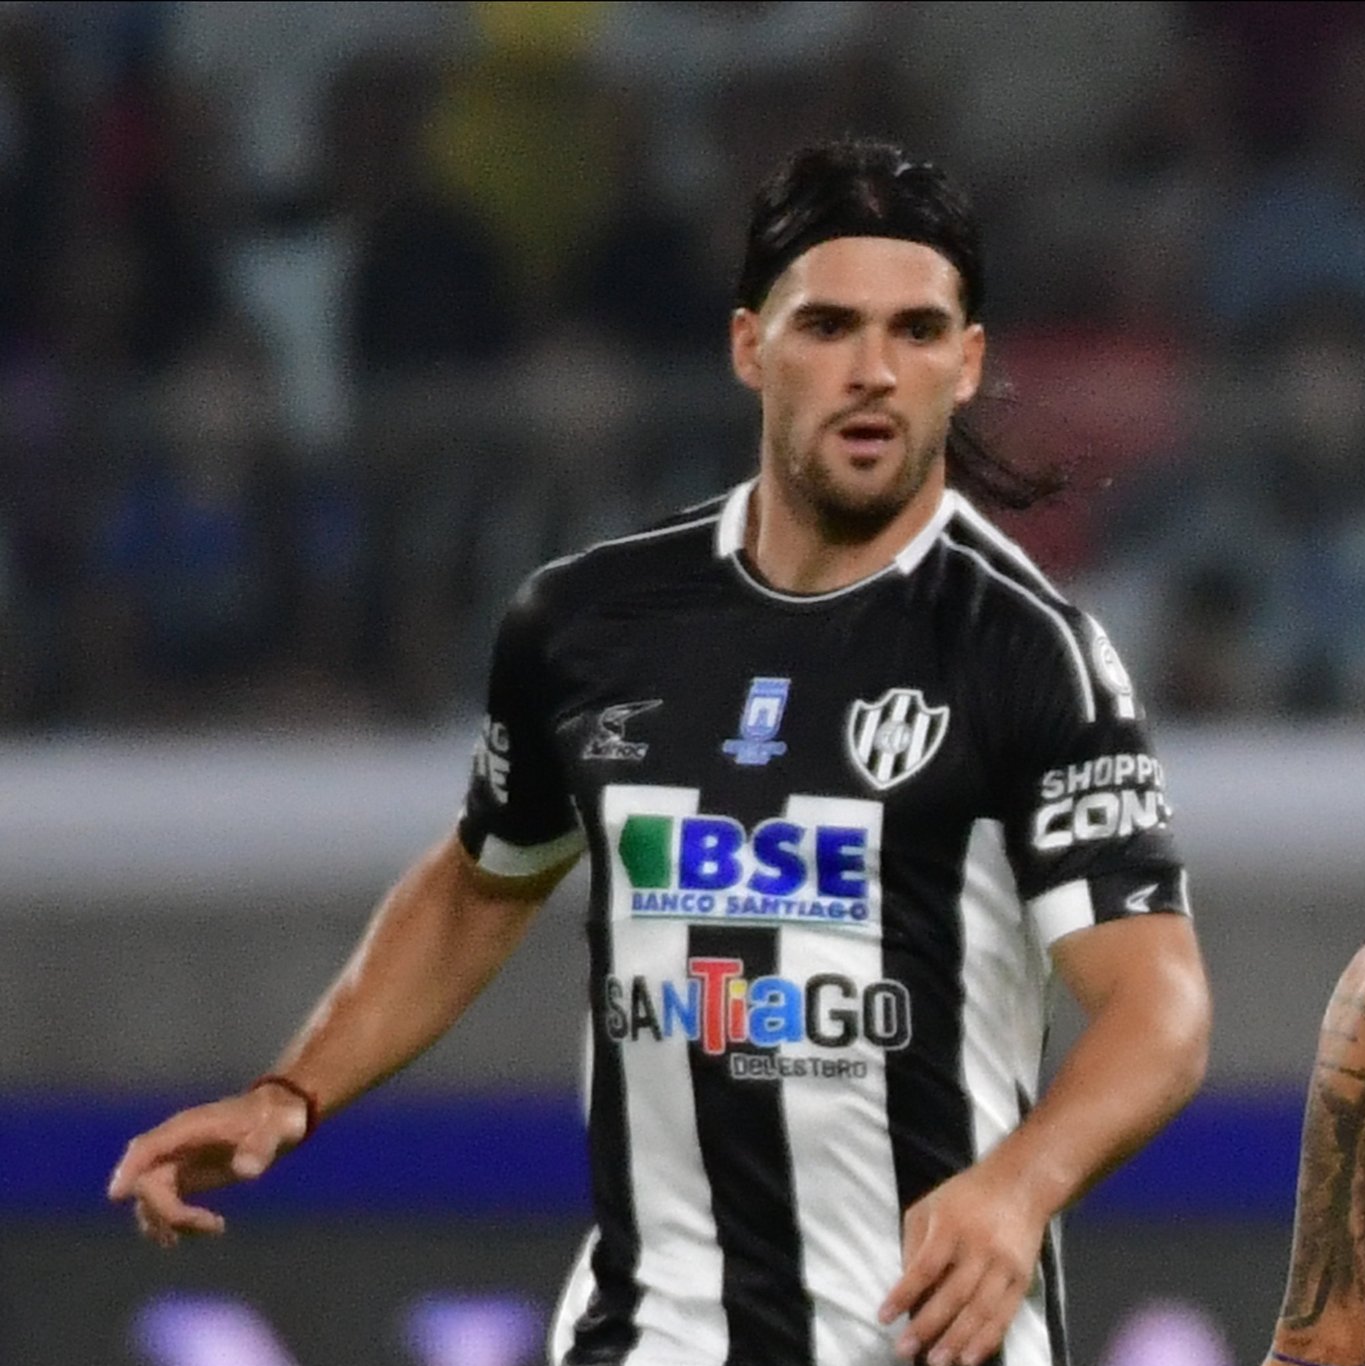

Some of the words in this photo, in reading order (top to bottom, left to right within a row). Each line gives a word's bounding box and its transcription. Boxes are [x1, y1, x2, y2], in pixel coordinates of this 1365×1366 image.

[677, 816, 868, 899] BSE
[632, 892, 716, 914] BANCO
[725, 894, 869, 922] SANTIAGO
